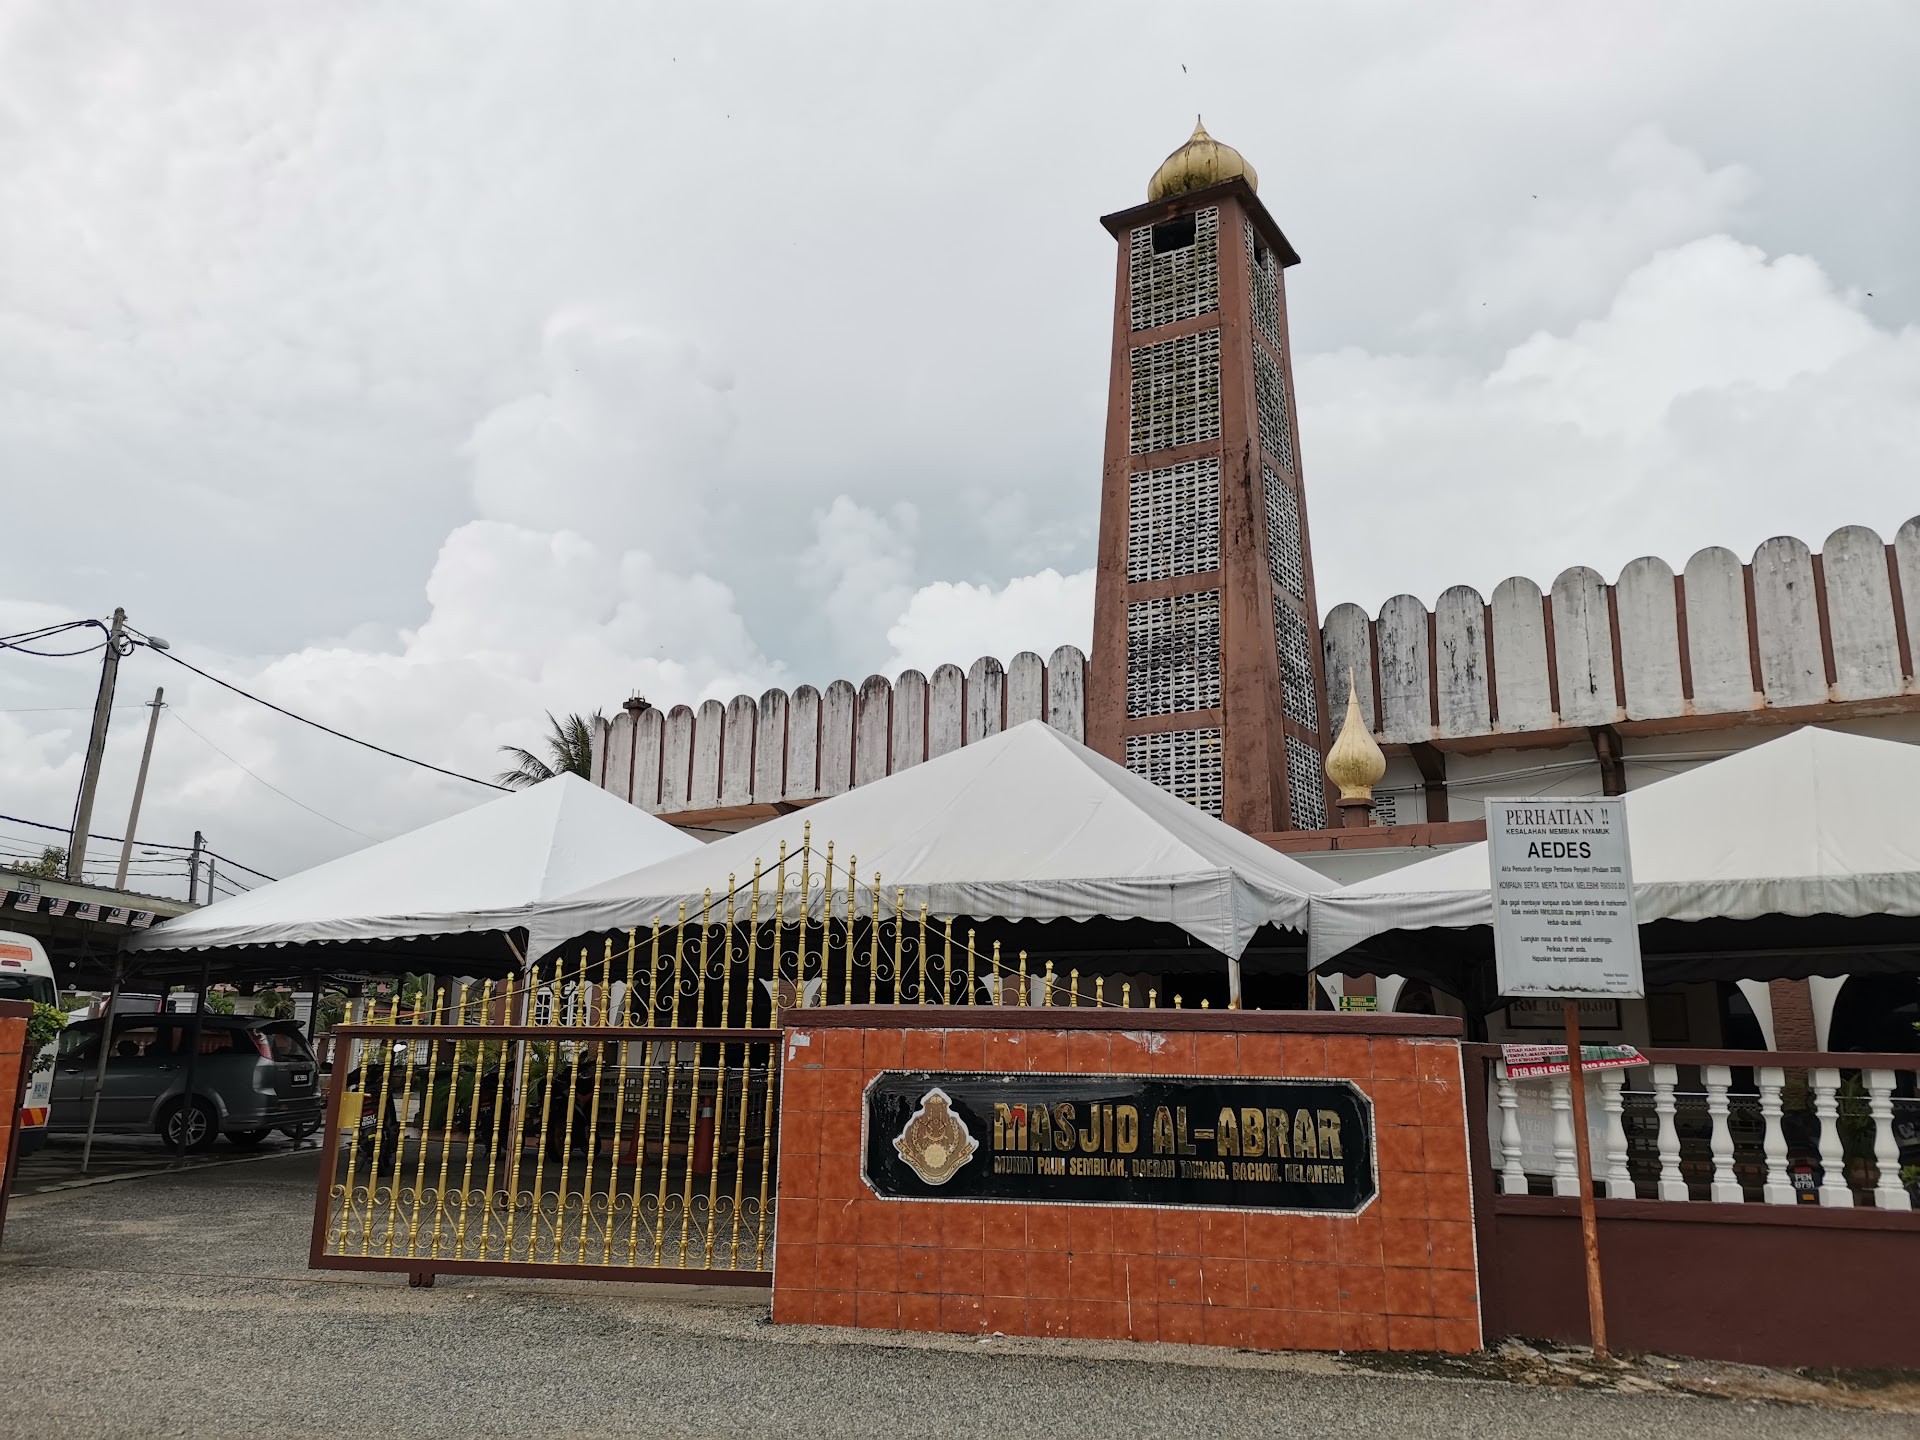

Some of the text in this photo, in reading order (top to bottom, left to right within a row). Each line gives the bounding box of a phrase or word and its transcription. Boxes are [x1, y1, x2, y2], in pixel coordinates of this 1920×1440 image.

[1506, 807, 1609, 826] PERHATIAN !!
[1528, 841, 1592, 859] AEDES
[1502, 865, 1511, 873] Akta
[1534, 865, 1552, 874] Serangga
[1554, 865, 1572, 873] Pembawa
[1574, 865, 1590, 874] Penyakit
[1499, 881, 1522, 890] KOMPAUN
[1524, 881, 1539, 890] SERTA
[1542, 881, 1558, 890] MERTA
[1560, 881, 1574, 890] TIDAK
[1576, 881, 1598, 890] MELEBIHI
[1509, 899, 1520, 908] gagal
[1542, 899, 1559, 907] kompaun
[1511, 908, 1521, 916] tidak
[1575, 910, 1590, 918] penjara
[1521, 935, 1539, 944] Luangkan
[1553, 935, 1562, 943] anda
[1553, 955, 1567, 964] tempat
[1514, 1001, 1537, 1011] RM
[993, 1102, 1344, 1159] MASJID AL-ABRAR
[994, 1156, 1034, 1175] MUKIM
[1037, 1156, 1066, 1175] PAUH
[1069, 1157, 1128, 1178] SEMBILAN,
[1132, 1158, 1176, 1178] DAERAH
[1285, 1163, 1345, 1184] KELANTAN
